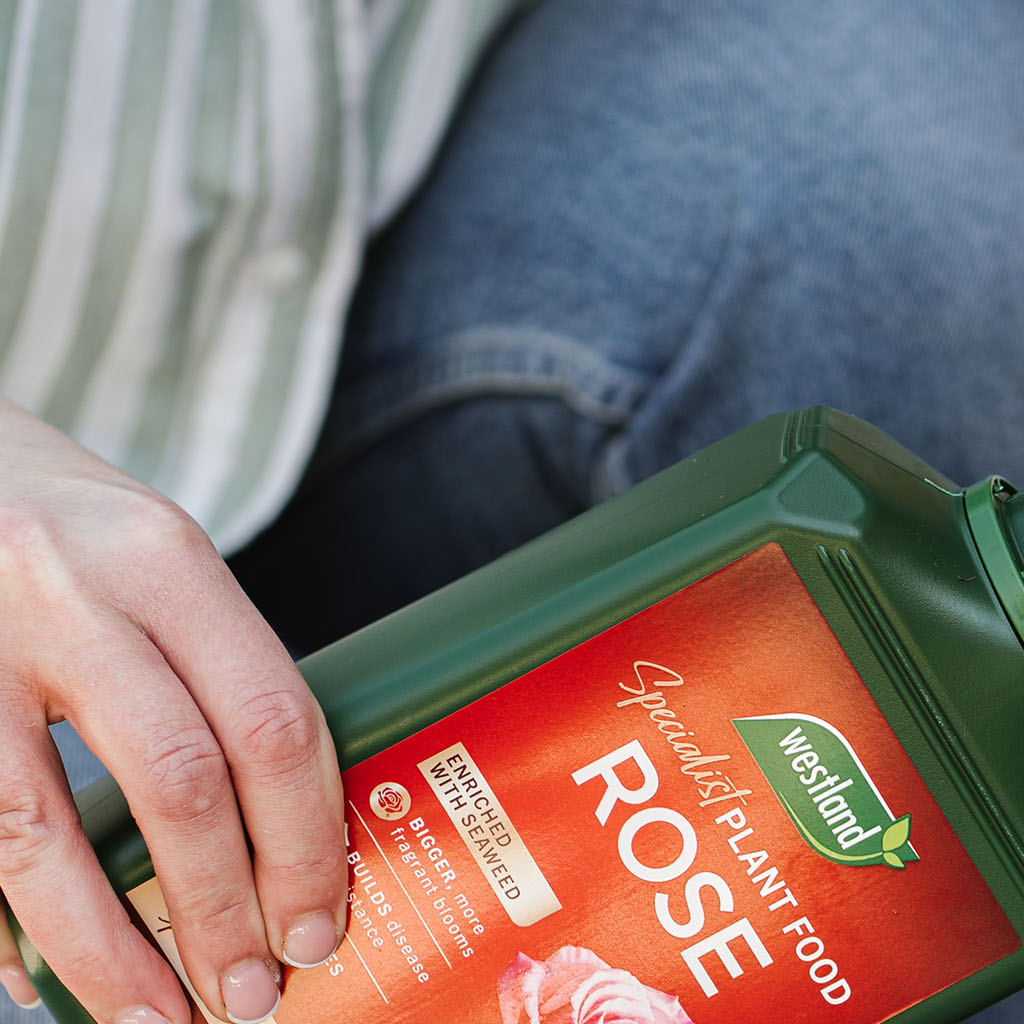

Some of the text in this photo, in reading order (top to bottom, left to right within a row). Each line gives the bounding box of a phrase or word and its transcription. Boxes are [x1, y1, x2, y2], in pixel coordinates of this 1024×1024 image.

[429, 761, 521, 900] WITH SEAWEED
[446, 753, 512, 847] ENRICHED
[617, 660, 852, 1005] Specialist PLANT FOOD
[777, 726, 882, 850] westland
[346, 885, 384, 948] istance
[347, 850, 429, 983] BUILDS disease
[390, 827, 474, 958] fragrant blooms
[408, 816, 485, 935] BIGGER, more
[571, 739, 773, 998] ROSE
